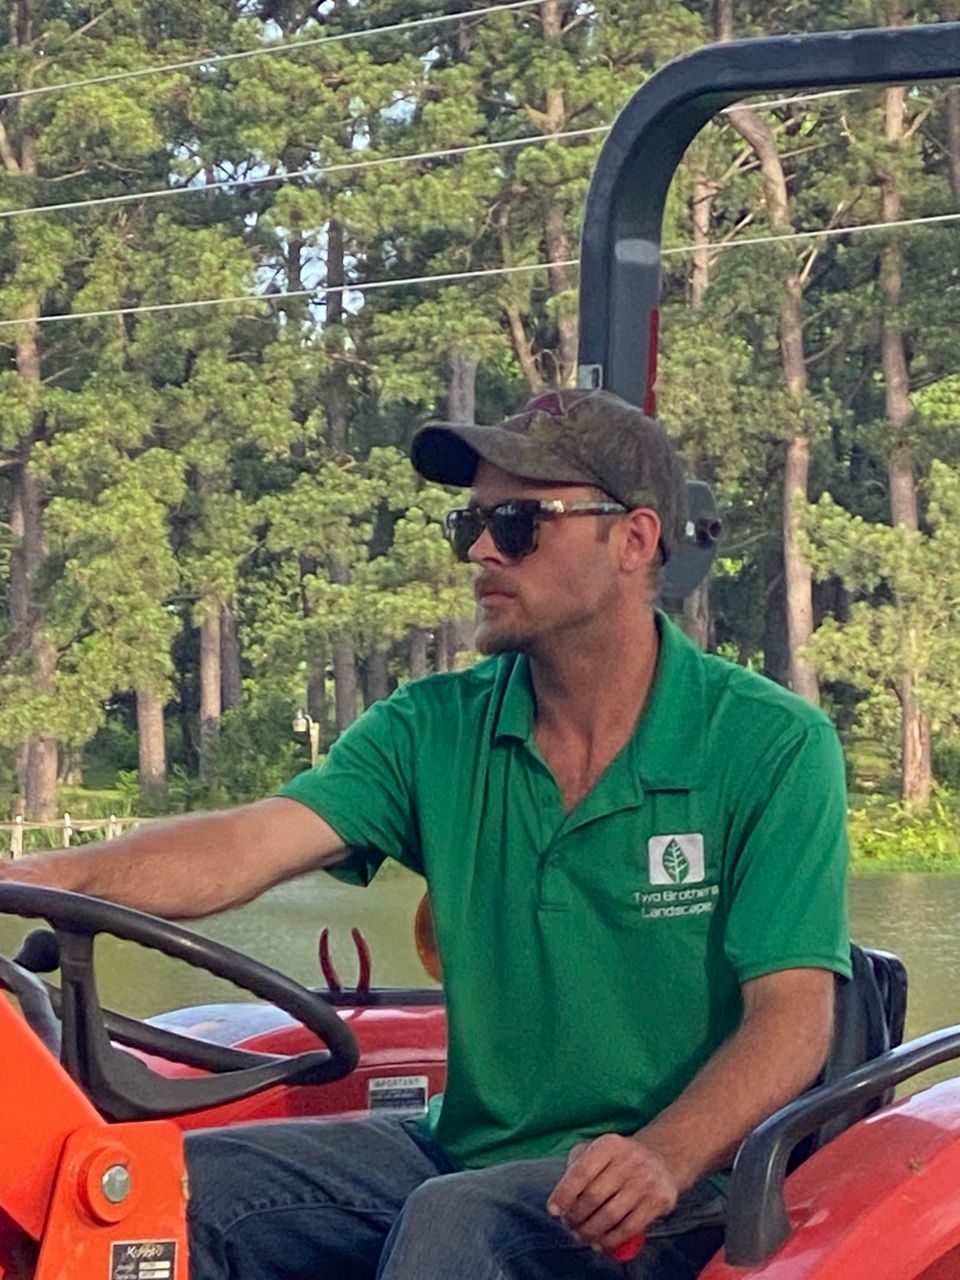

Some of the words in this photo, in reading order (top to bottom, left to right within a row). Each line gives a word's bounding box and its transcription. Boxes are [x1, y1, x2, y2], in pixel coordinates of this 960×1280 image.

[633, 891, 661, 904] Two
[663, 885, 719, 901] Brothers
[642, 902, 713, 918] Landscape
